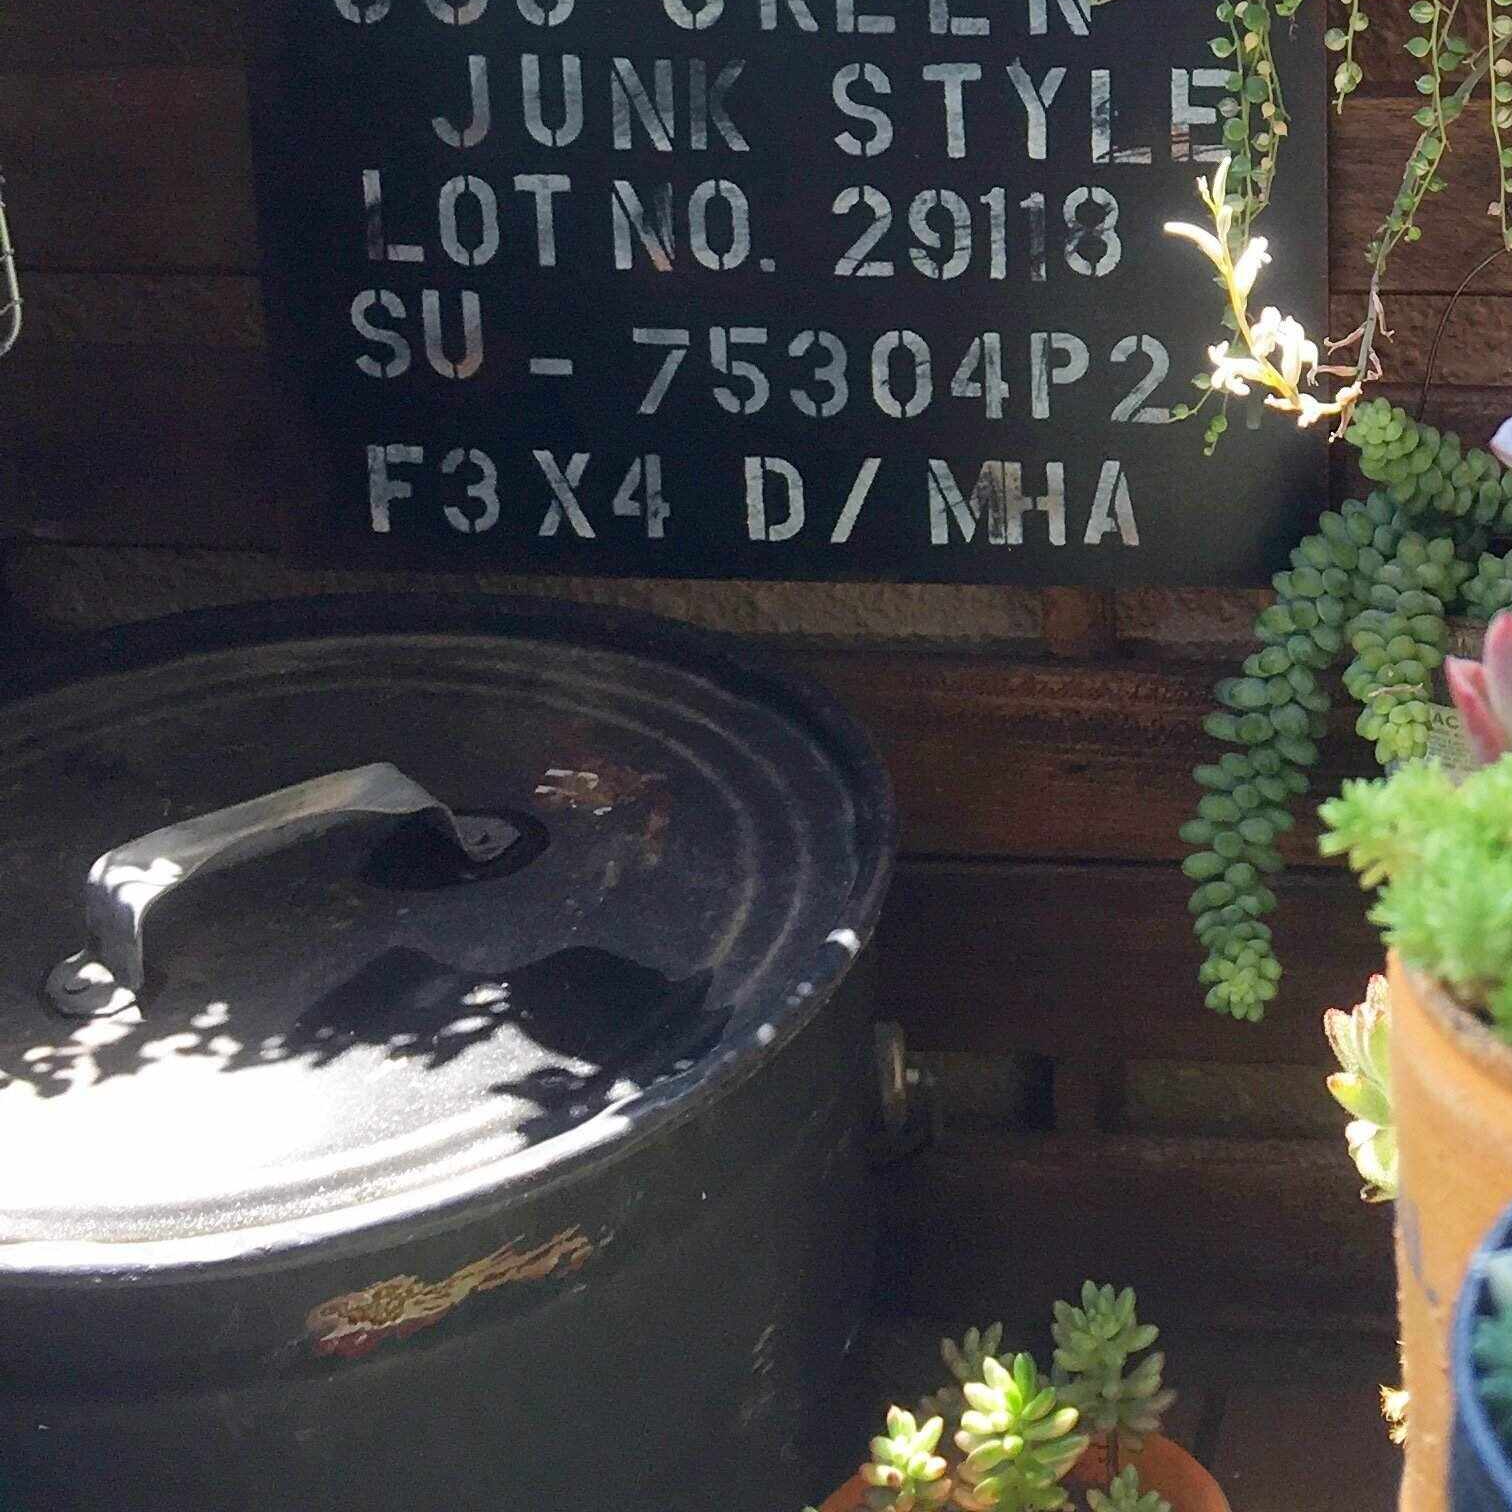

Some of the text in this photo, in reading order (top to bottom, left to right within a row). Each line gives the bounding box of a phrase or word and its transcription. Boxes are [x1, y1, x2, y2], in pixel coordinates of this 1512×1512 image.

[431, 52, 1240, 166] JUNK STYLE
[361, 168, 1123, 283] LOT NO. 29118
[349, 287, 484, 380] SU
